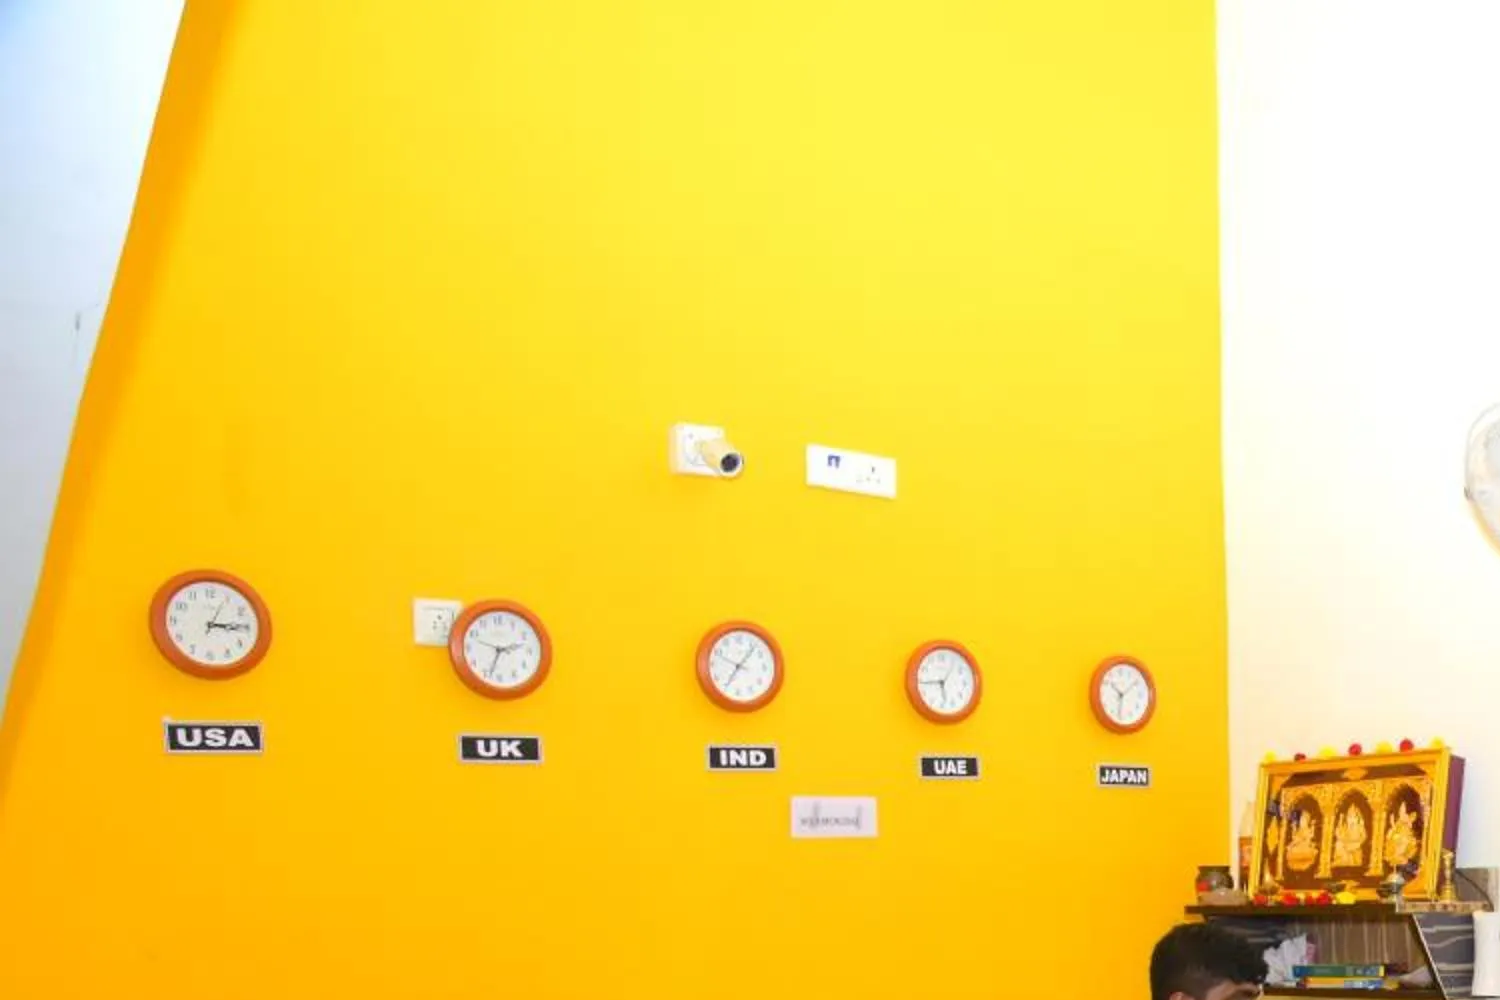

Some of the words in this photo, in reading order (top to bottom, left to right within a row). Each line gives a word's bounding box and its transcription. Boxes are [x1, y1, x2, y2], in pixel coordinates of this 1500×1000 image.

[176, 727, 254, 747] USA
[476, 739, 524, 758] UK
[720, 749, 767, 766] IND
[933, 759, 967, 775] UAE
[1101, 769, 1147, 783] JAPAN
